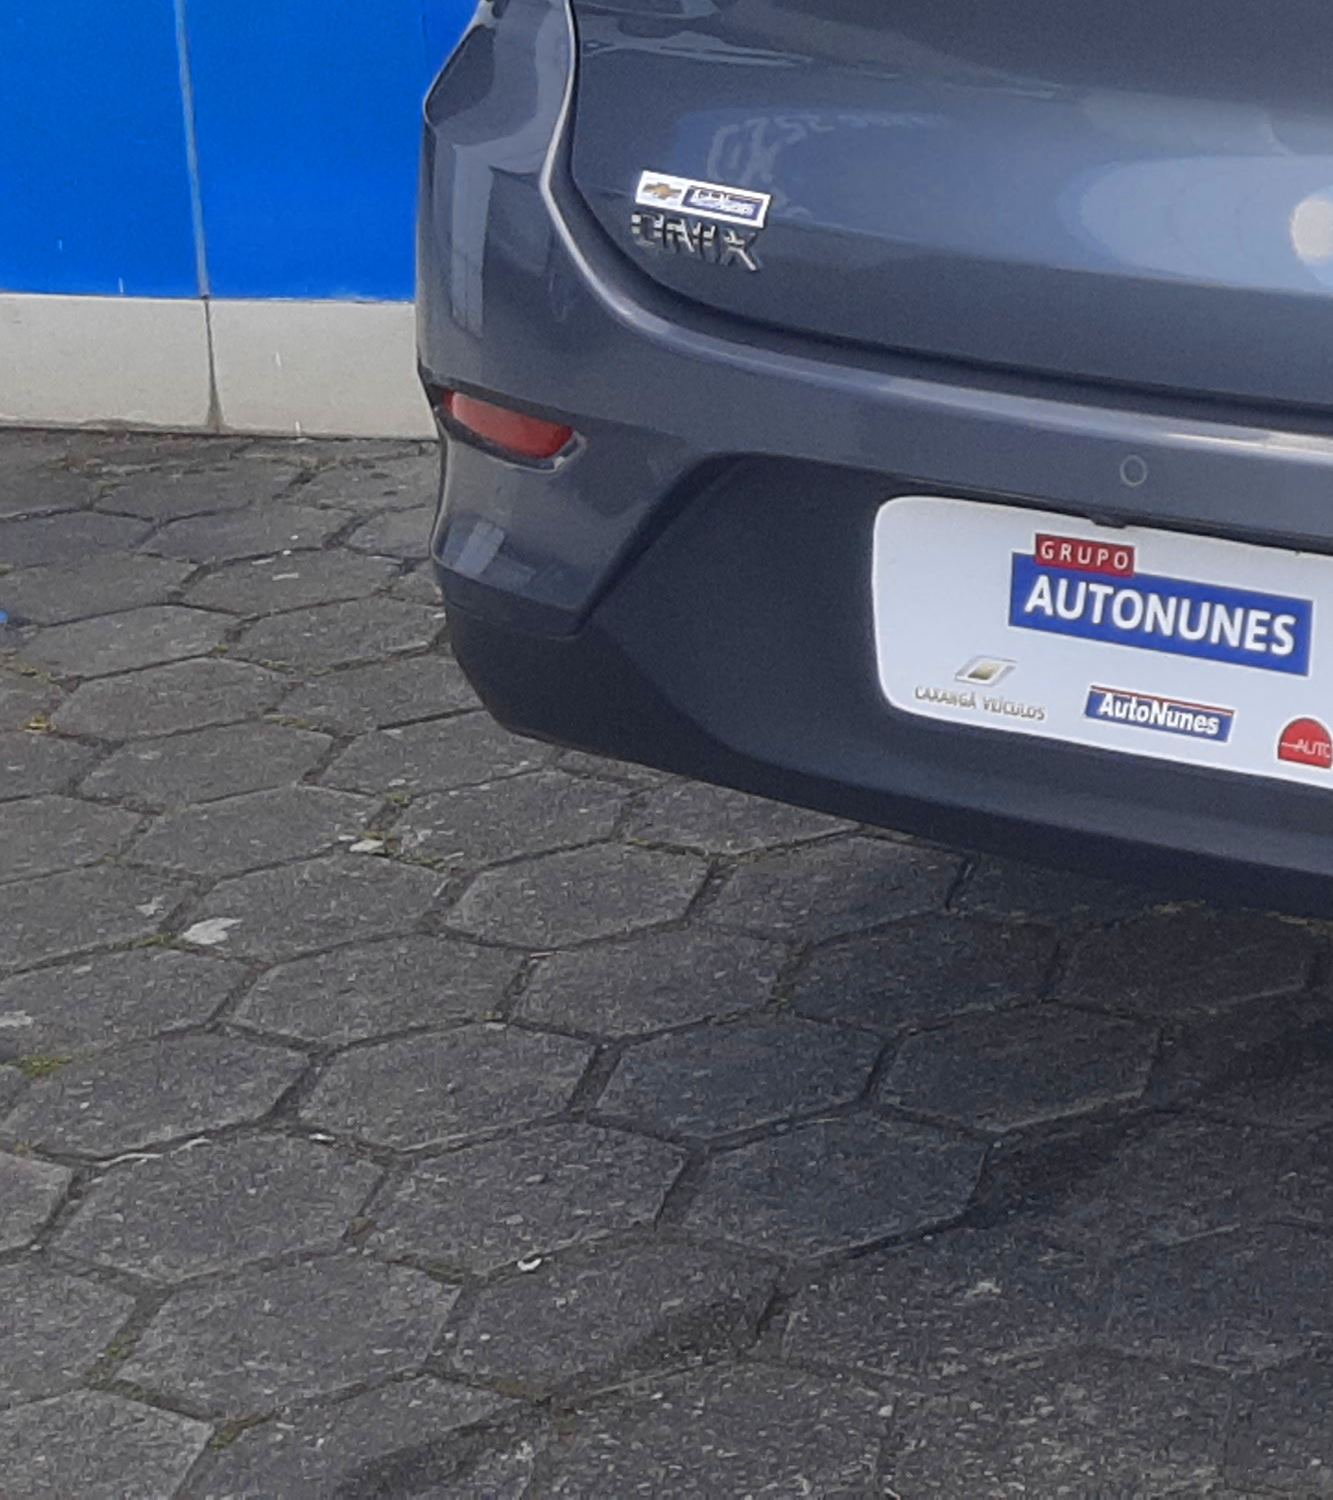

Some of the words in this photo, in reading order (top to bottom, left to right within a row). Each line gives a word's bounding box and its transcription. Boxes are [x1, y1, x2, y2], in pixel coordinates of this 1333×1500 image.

[1040, 540, 1130, 570] GRUPO
[1024, 574, 1298, 656] AUTONUNES
[1099, 692, 1220, 736] AutoNunes
